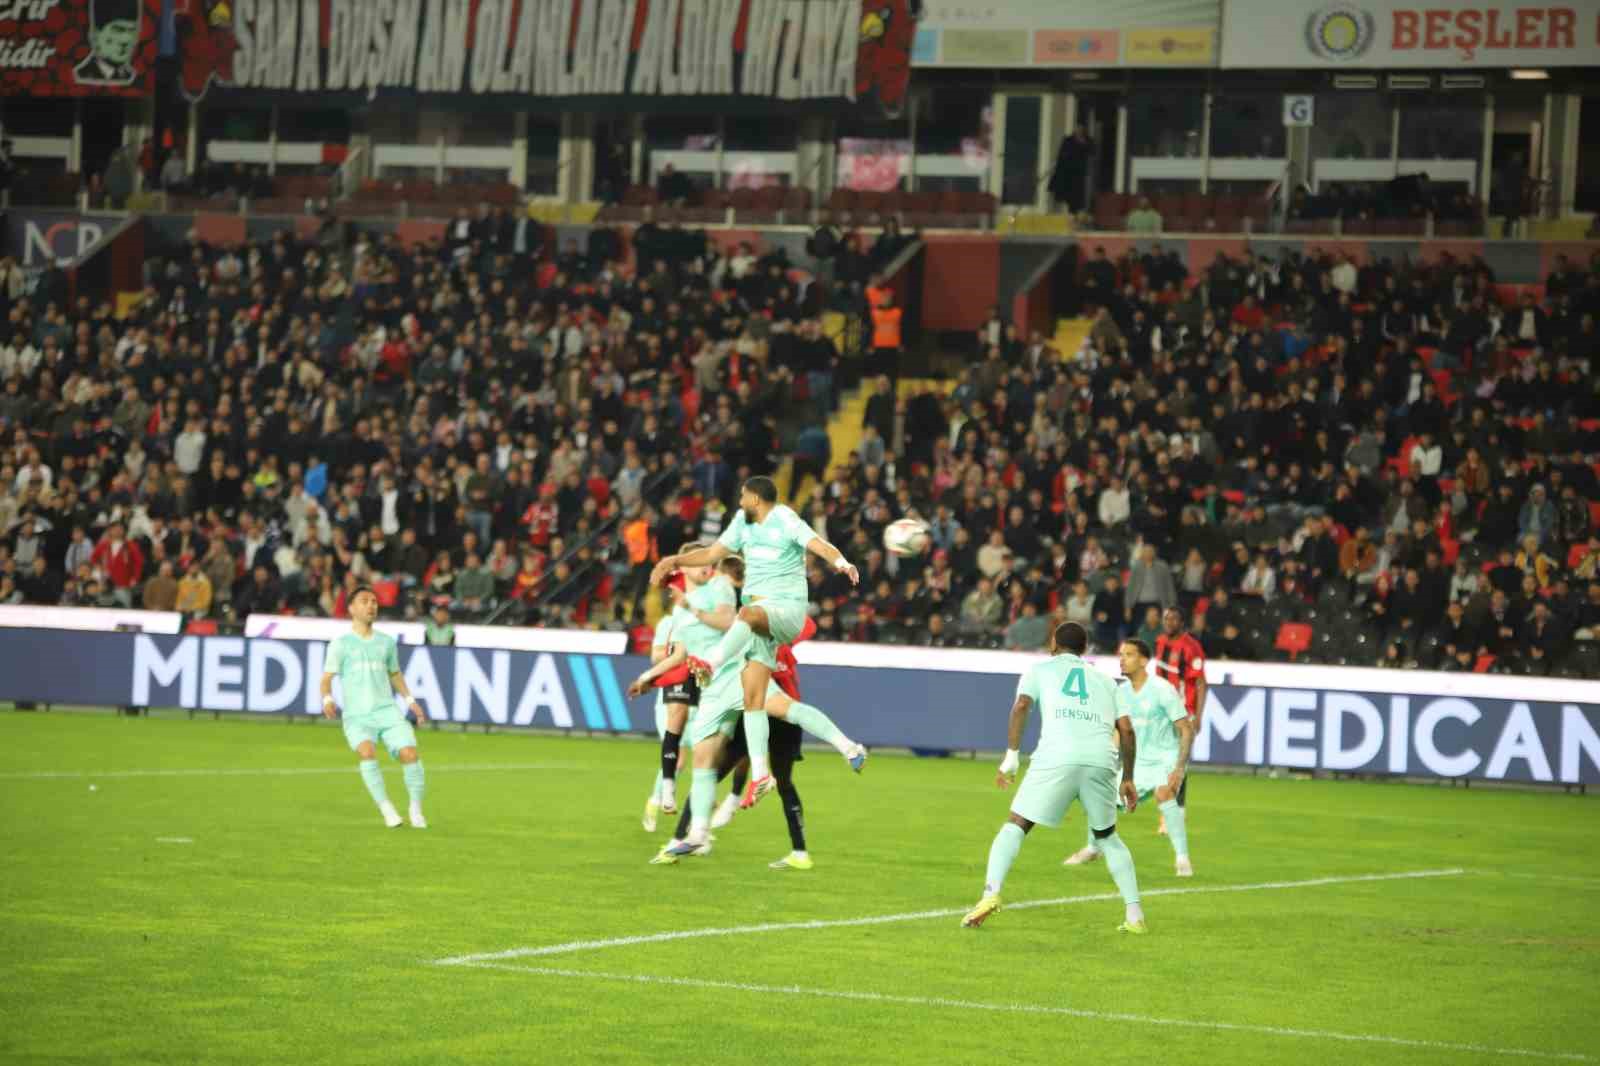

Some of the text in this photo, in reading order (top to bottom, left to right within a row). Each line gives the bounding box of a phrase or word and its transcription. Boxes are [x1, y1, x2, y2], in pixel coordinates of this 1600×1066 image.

[1391, 8, 1577, 61] BEŞLER
[1291, 101, 1307, 122] G
[131, 633, 574, 728] MEDIANA
[1062, 667, 1089, 705] 4
